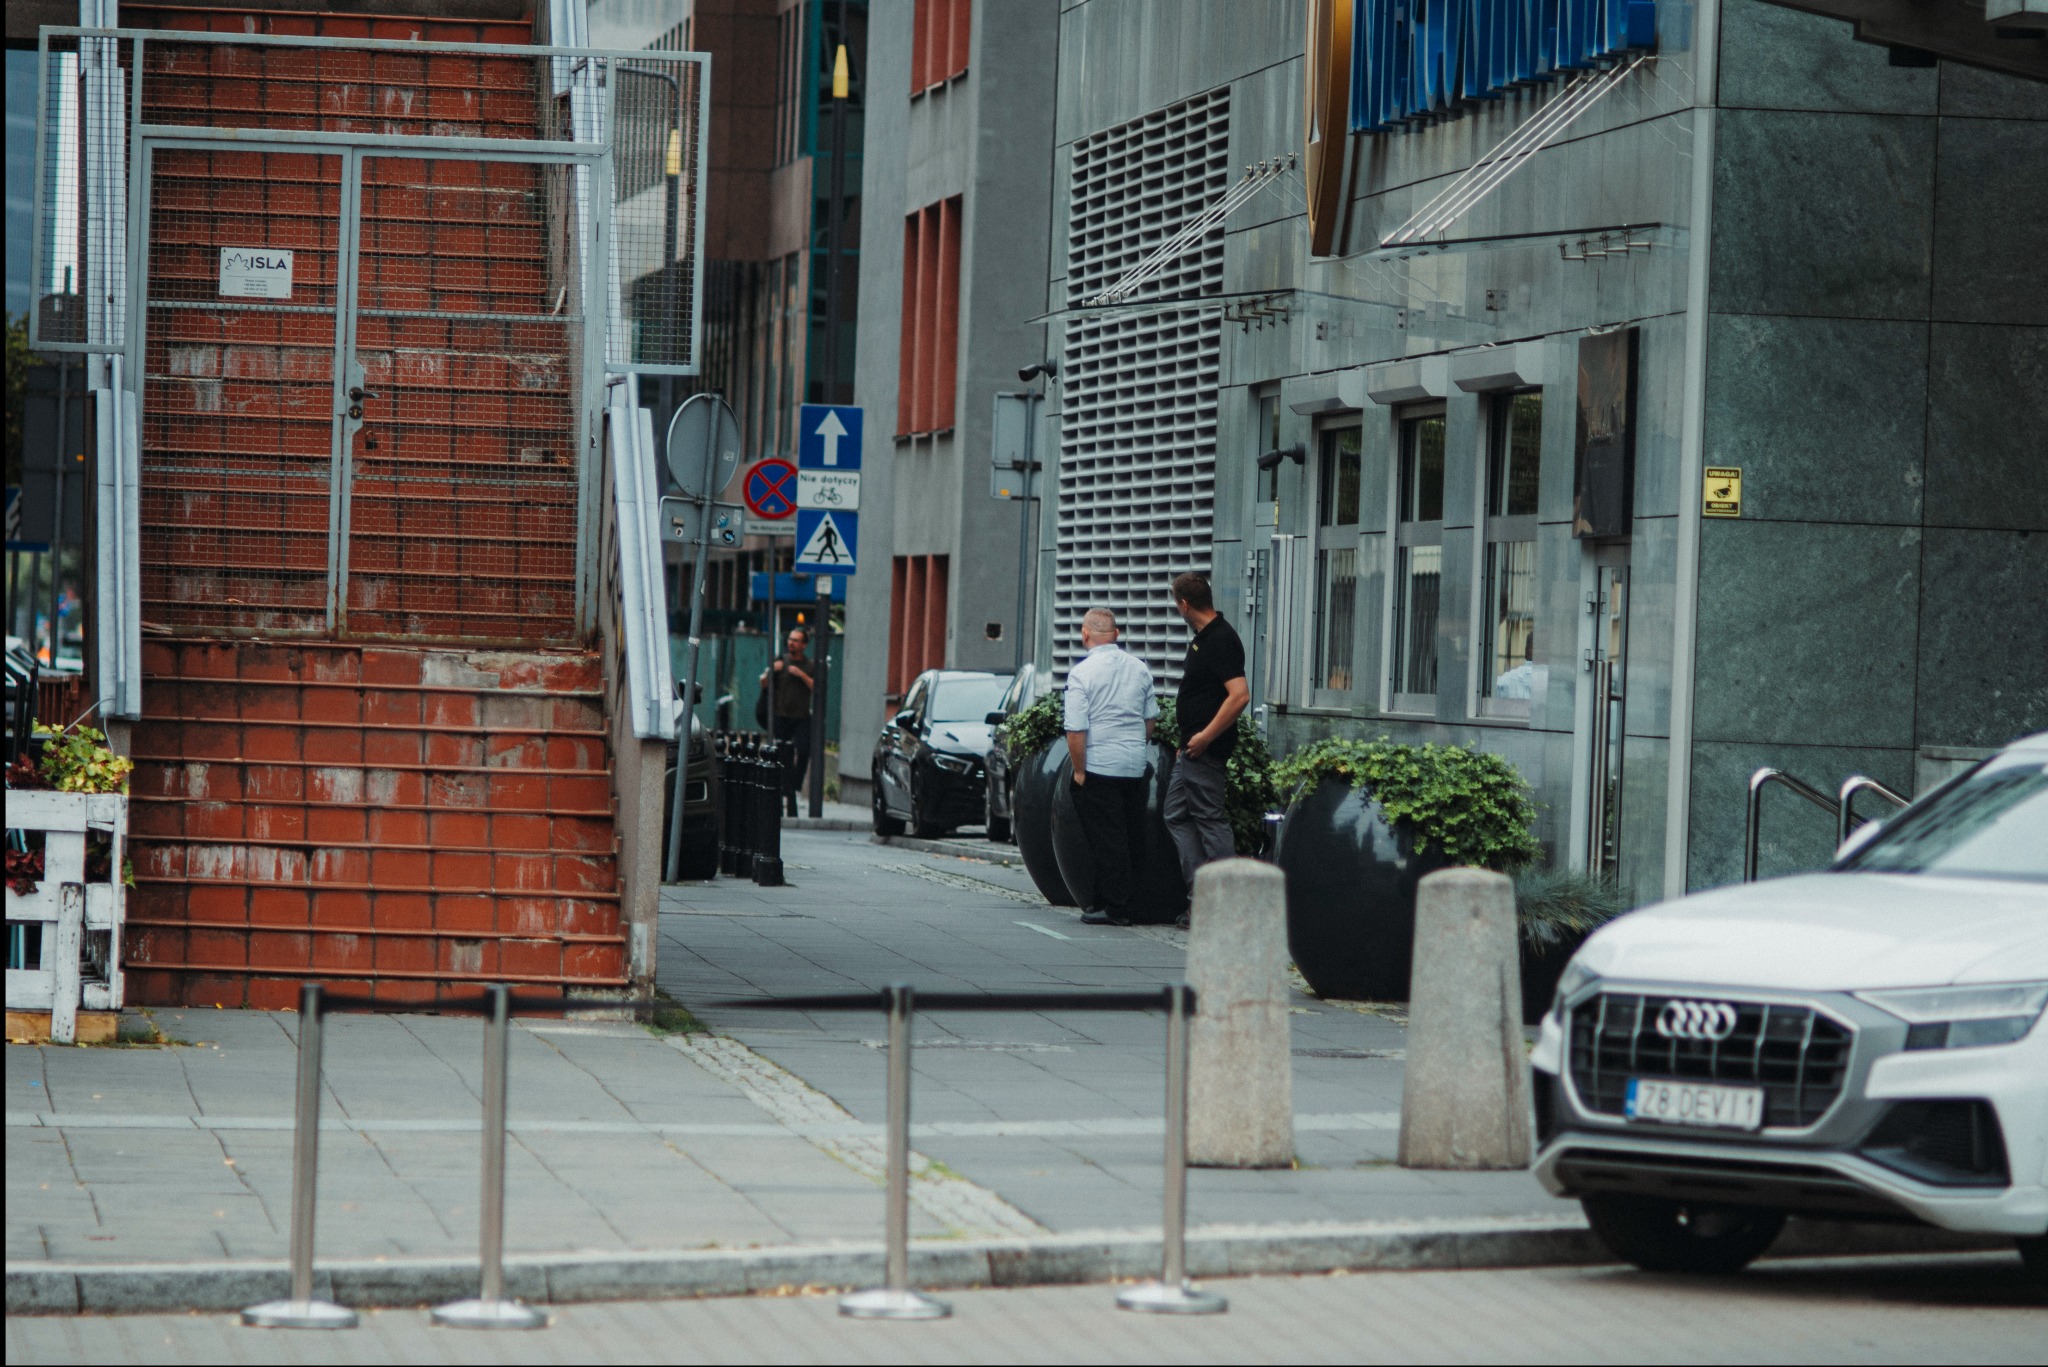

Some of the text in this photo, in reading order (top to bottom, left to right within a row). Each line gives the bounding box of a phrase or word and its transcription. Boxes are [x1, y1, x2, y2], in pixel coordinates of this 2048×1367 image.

[250, 256, 287, 270] ISLA
[800, 473, 858, 487] Nie dotyczy
[1708, 470, 1738, 478] UWAGA!
[1642, 1085, 1670, 1115] Z8
